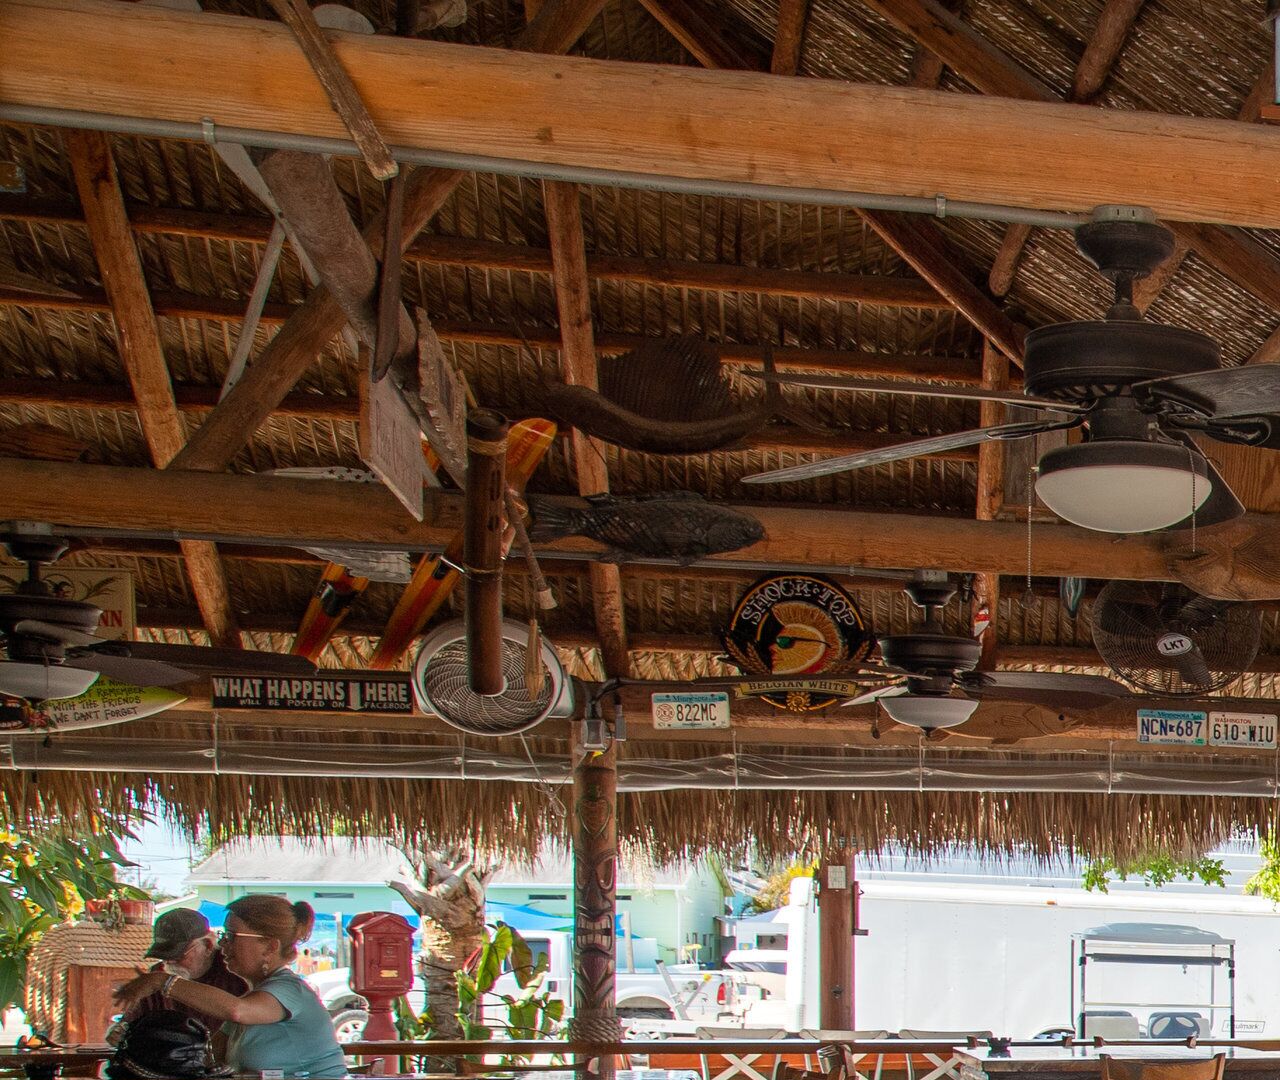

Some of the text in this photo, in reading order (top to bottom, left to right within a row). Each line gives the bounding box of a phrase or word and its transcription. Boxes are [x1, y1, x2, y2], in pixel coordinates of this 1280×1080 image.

[1163, 640, 1184, 651] LKT
[213, 677, 408, 702] WHAT HAPPENS HERE
[808, 681, 849, 693] WHITE
[52, 702, 76, 712] WITH
[81, 699, 98, 709] THE
[102, 696, 142, 708] FRIENDS
[239, 698, 262, 706] WILL
[287, 700, 325, 708] POSTED
[364, 701, 411, 709] FACEBOOK
[54, 713, 69, 723] WE
[104, 707, 139, 720] FORGET
[676, 703, 717, 721] 822MC
[1141, 718, 1203, 738] NCN 687
